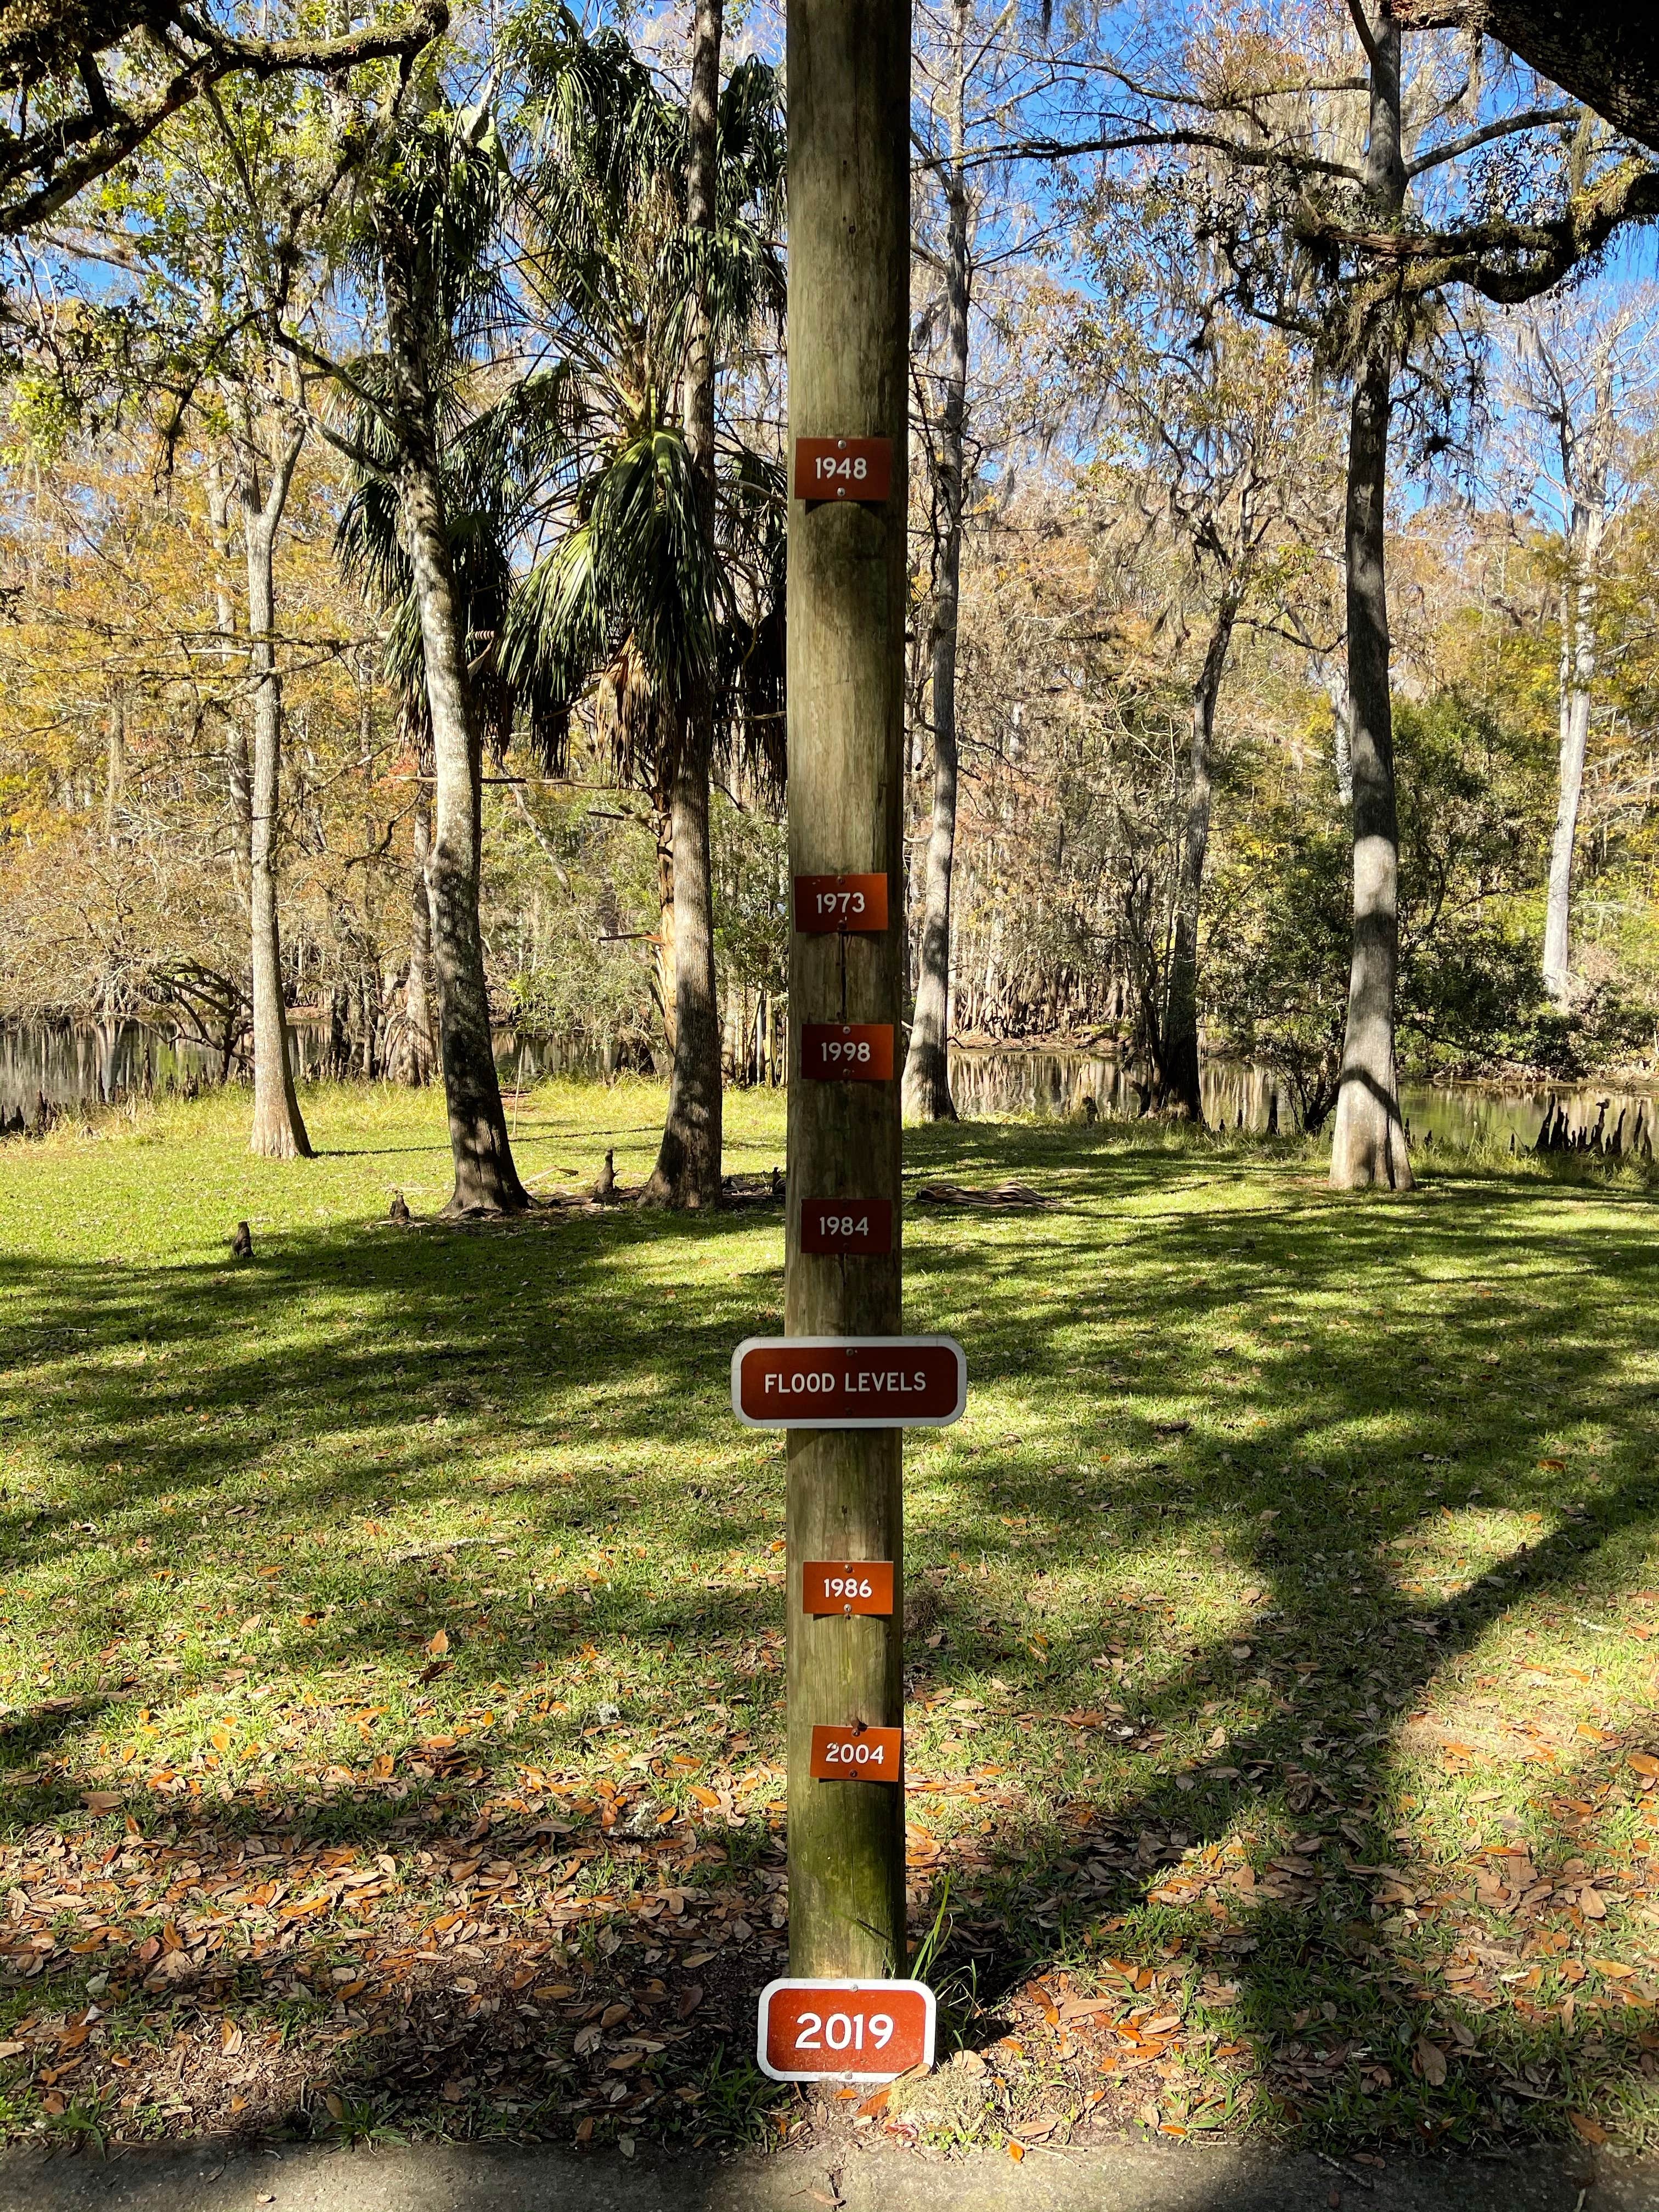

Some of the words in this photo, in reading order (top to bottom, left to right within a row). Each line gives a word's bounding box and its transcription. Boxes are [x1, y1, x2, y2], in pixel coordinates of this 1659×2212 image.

[815, 458, 867, 479] 1948
[816, 892, 865, 913] 1973
[821, 1042, 871, 1062] 1998
[819, 1216, 869, 1236] 1984
[765, 1373, 835, 1393] FLOOD
[845, 1372, 926, 1392] LEVELS
[824, 1578, 872, 1598] 1986
[825, 1743, 884, 1764] 2004
[795, 2012, 894, 2051] 2019
